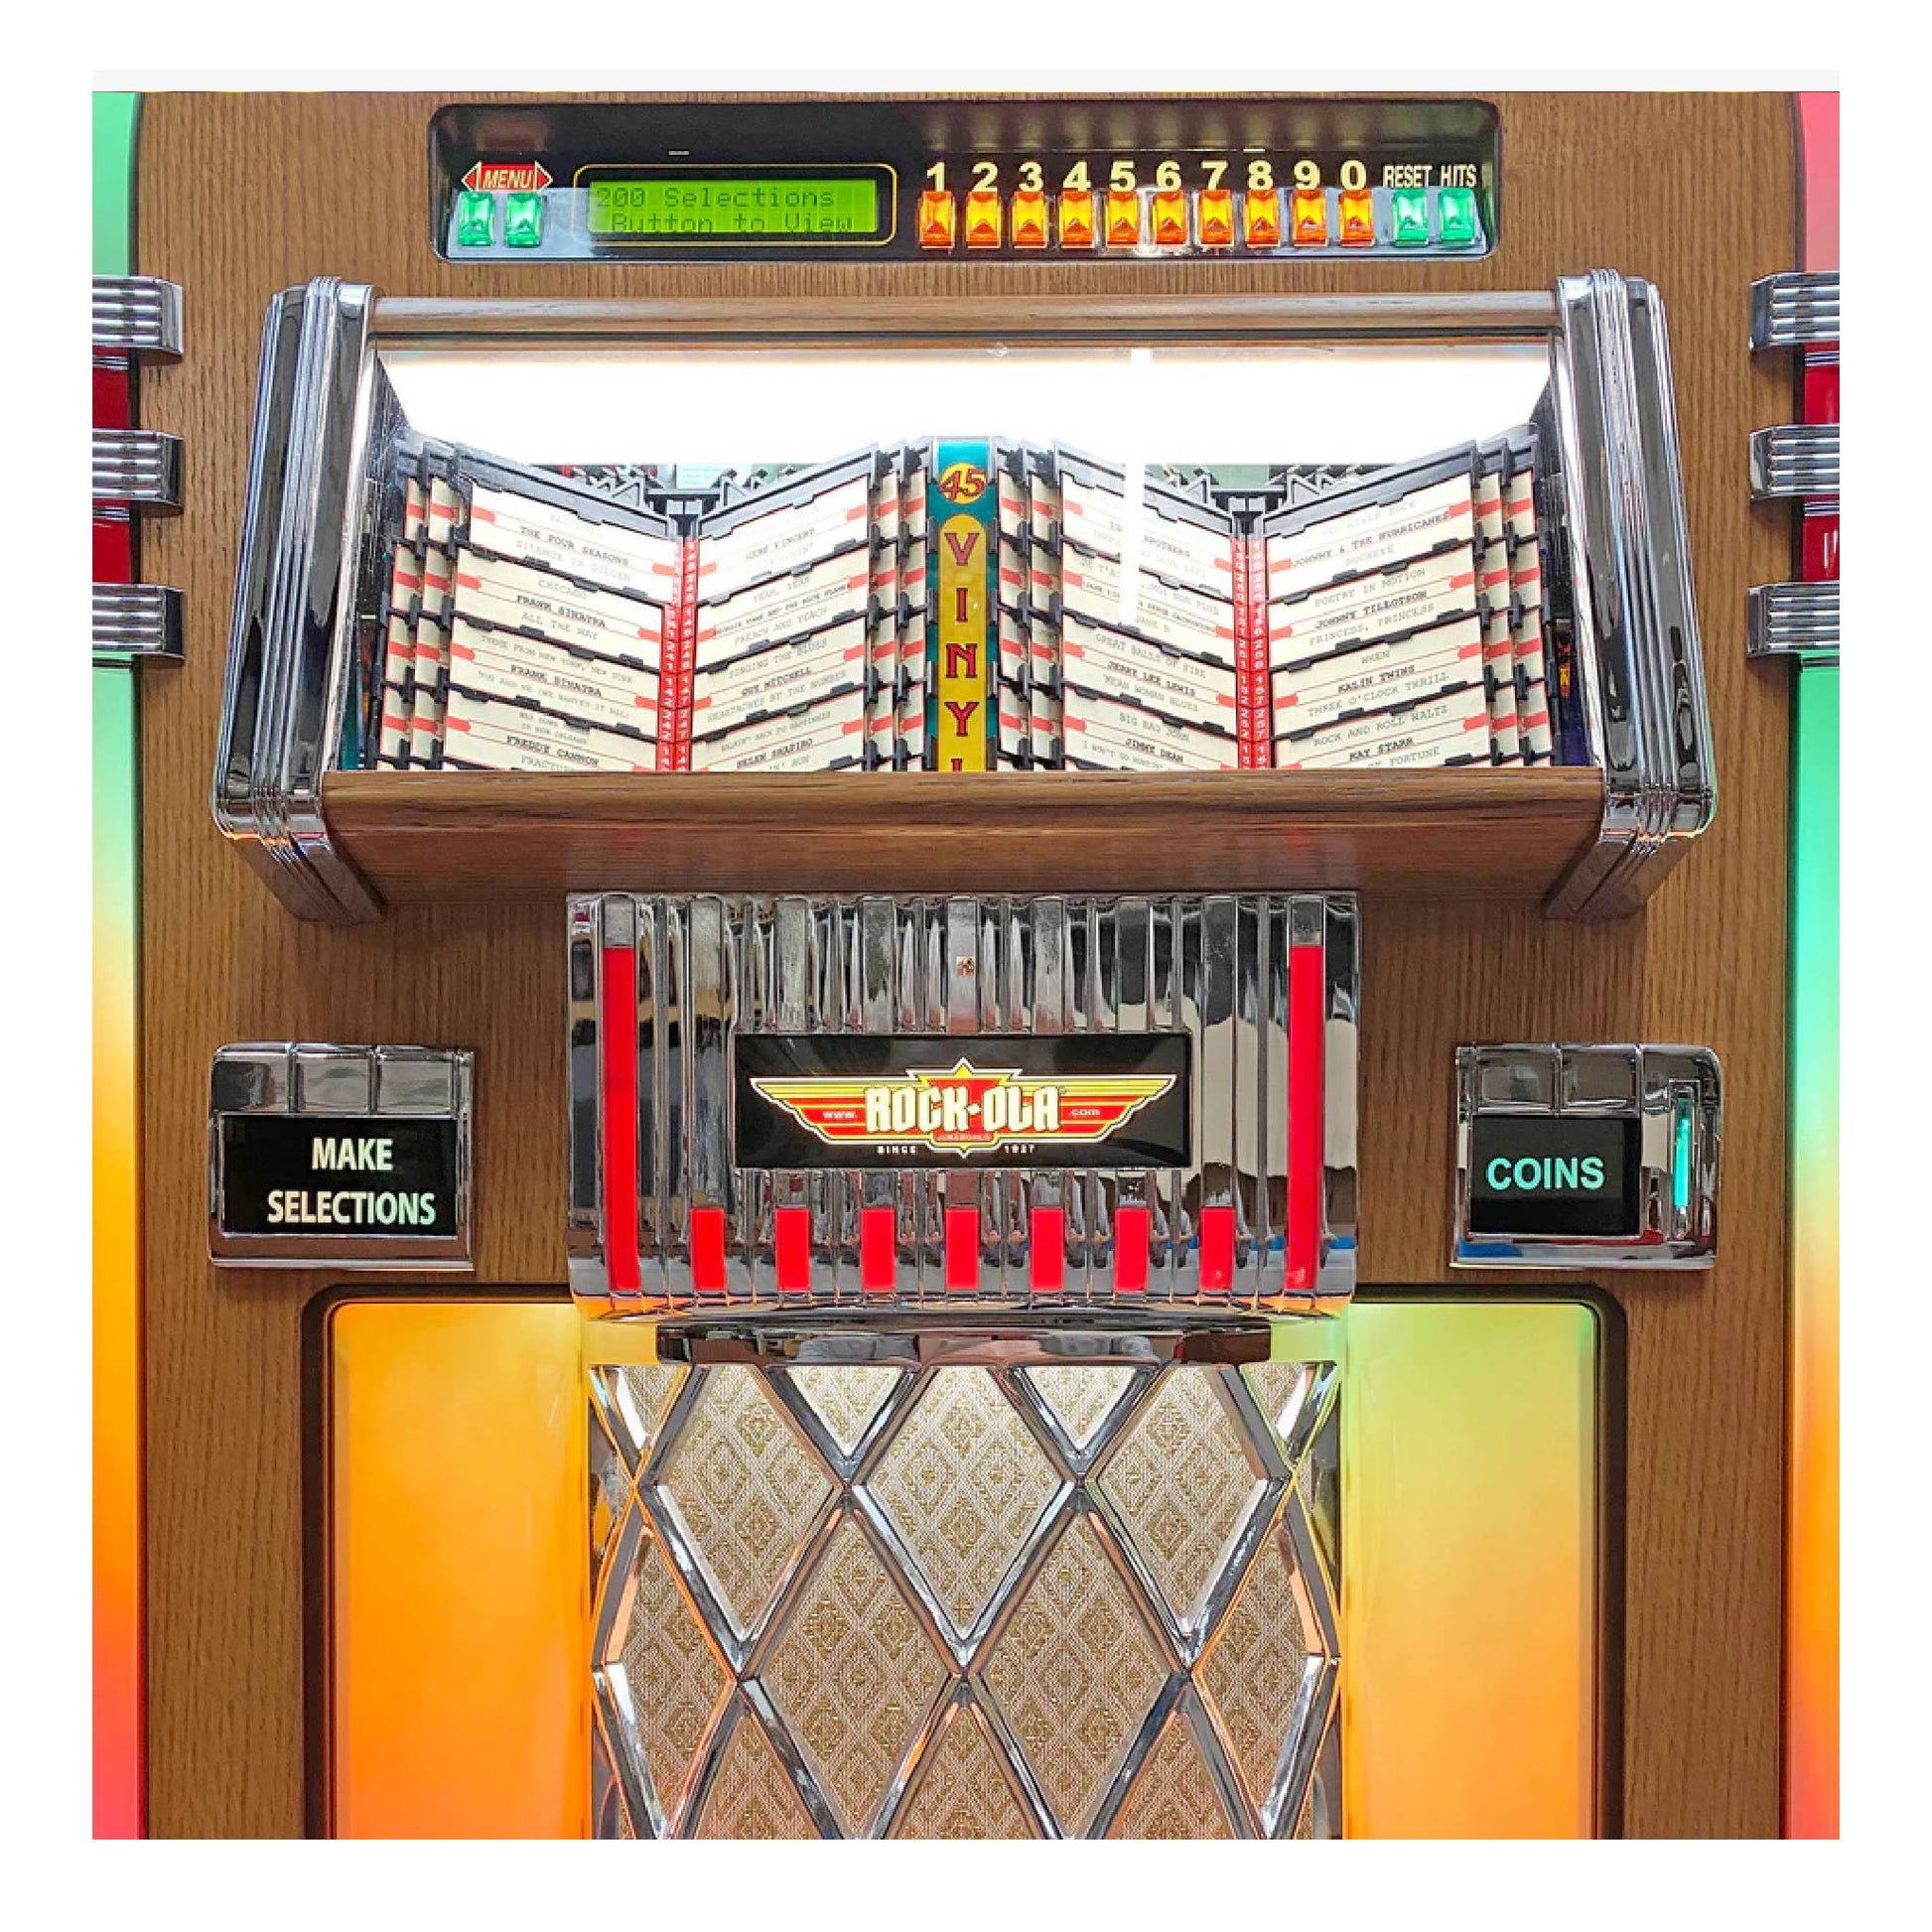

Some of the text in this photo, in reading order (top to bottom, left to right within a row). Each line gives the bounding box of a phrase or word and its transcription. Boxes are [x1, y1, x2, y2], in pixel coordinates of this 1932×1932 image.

[483, 169, 533, 191] MENU
[926, 161, 1367, 191] 1 2 3 4 5 6 7 8 9 0
[1381, 164, 1433, 189] RESET
[1441, 164, 1476, 188] HITS
[597, 187, 835, 207] 200 Selections
[611, 212, 853, 233] Button to View
[938, 469, 986, 502] 45
[510, 664, 603, 697] FRANK SINATRA
[1380, 665, 1416, 682] TWINS
[311, 1138, 393, 1172] MAKE
[1486, 1157, 1606, 1190] COINS
[266, 1189, 437, 1226] SELECTIONS
